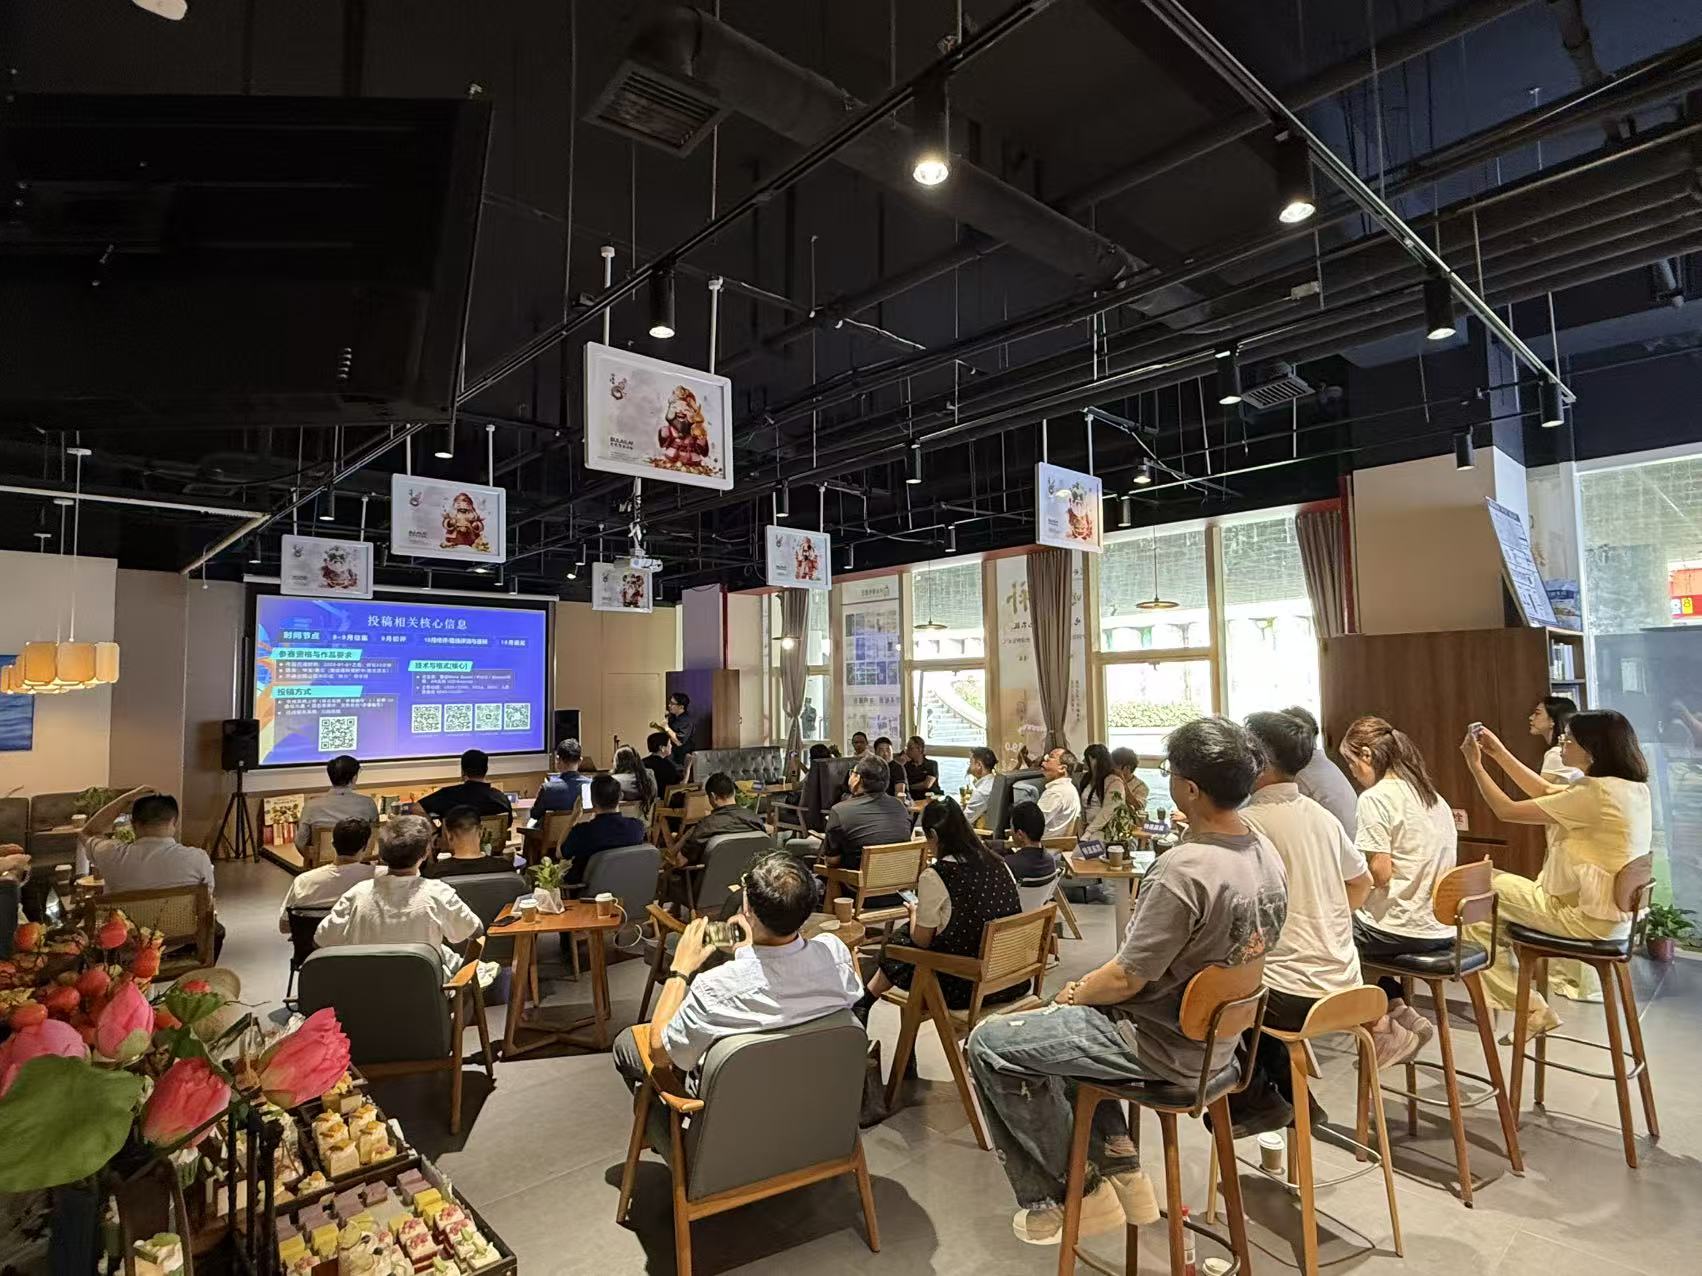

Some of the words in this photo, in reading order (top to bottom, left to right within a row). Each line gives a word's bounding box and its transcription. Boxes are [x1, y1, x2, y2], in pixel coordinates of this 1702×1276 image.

[367, 614, 468, 630] 投稿相关核心信息
[277, 688, 312, 696] 投稿方式
